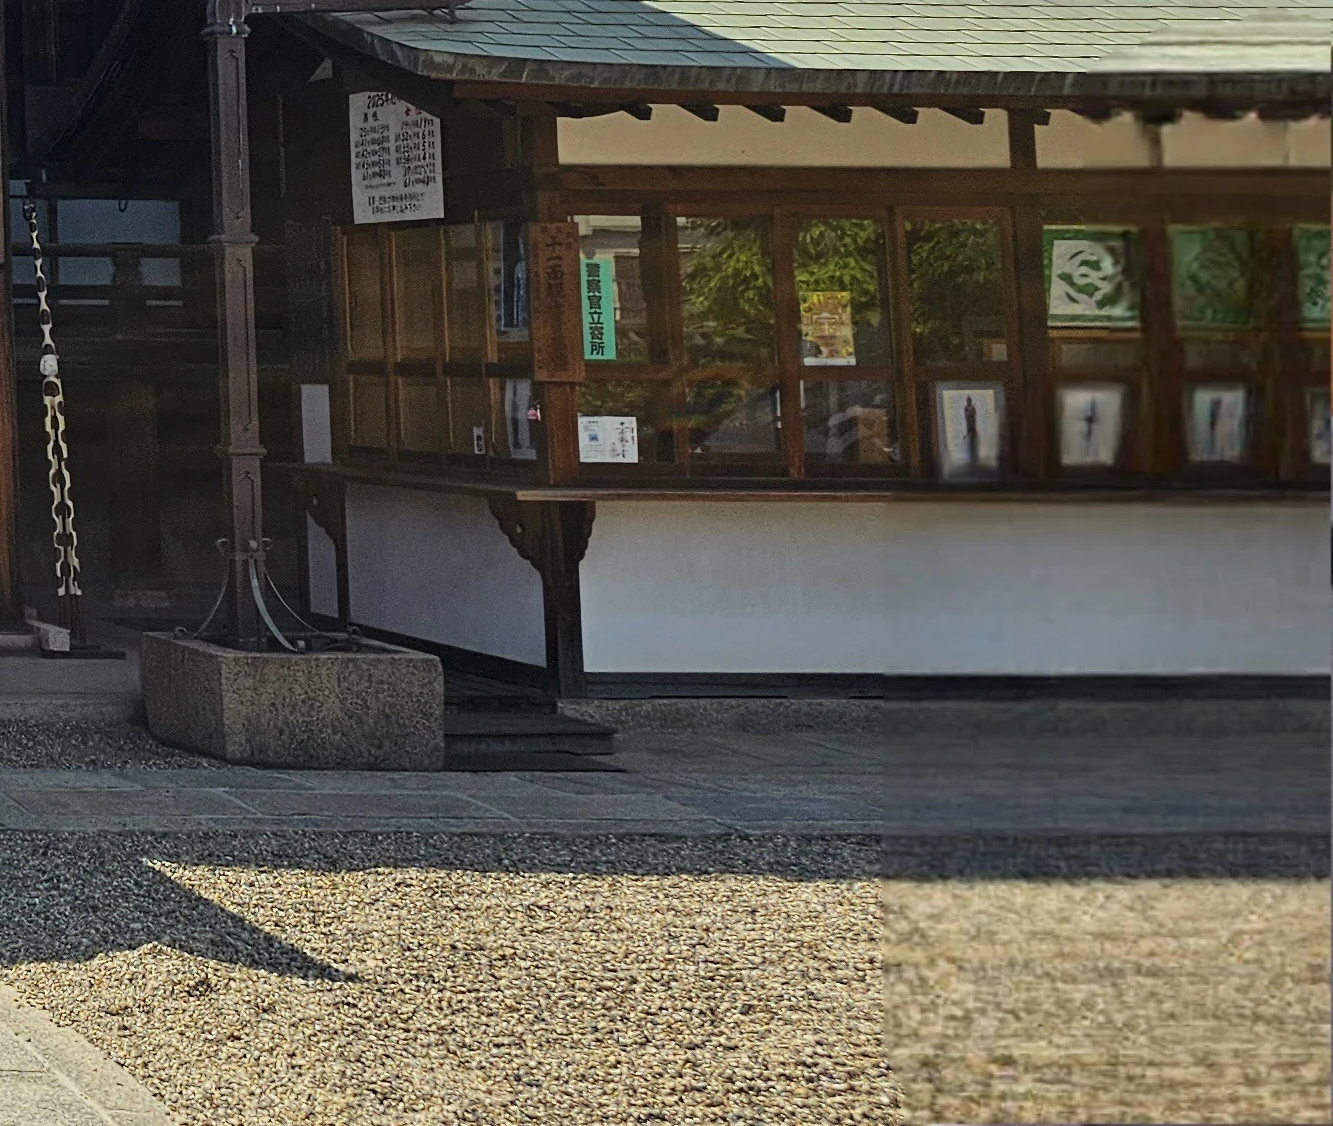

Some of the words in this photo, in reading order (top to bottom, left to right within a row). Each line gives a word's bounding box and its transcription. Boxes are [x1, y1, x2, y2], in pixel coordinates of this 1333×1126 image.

[585, 262, 605, 356] 警察官立寄所
